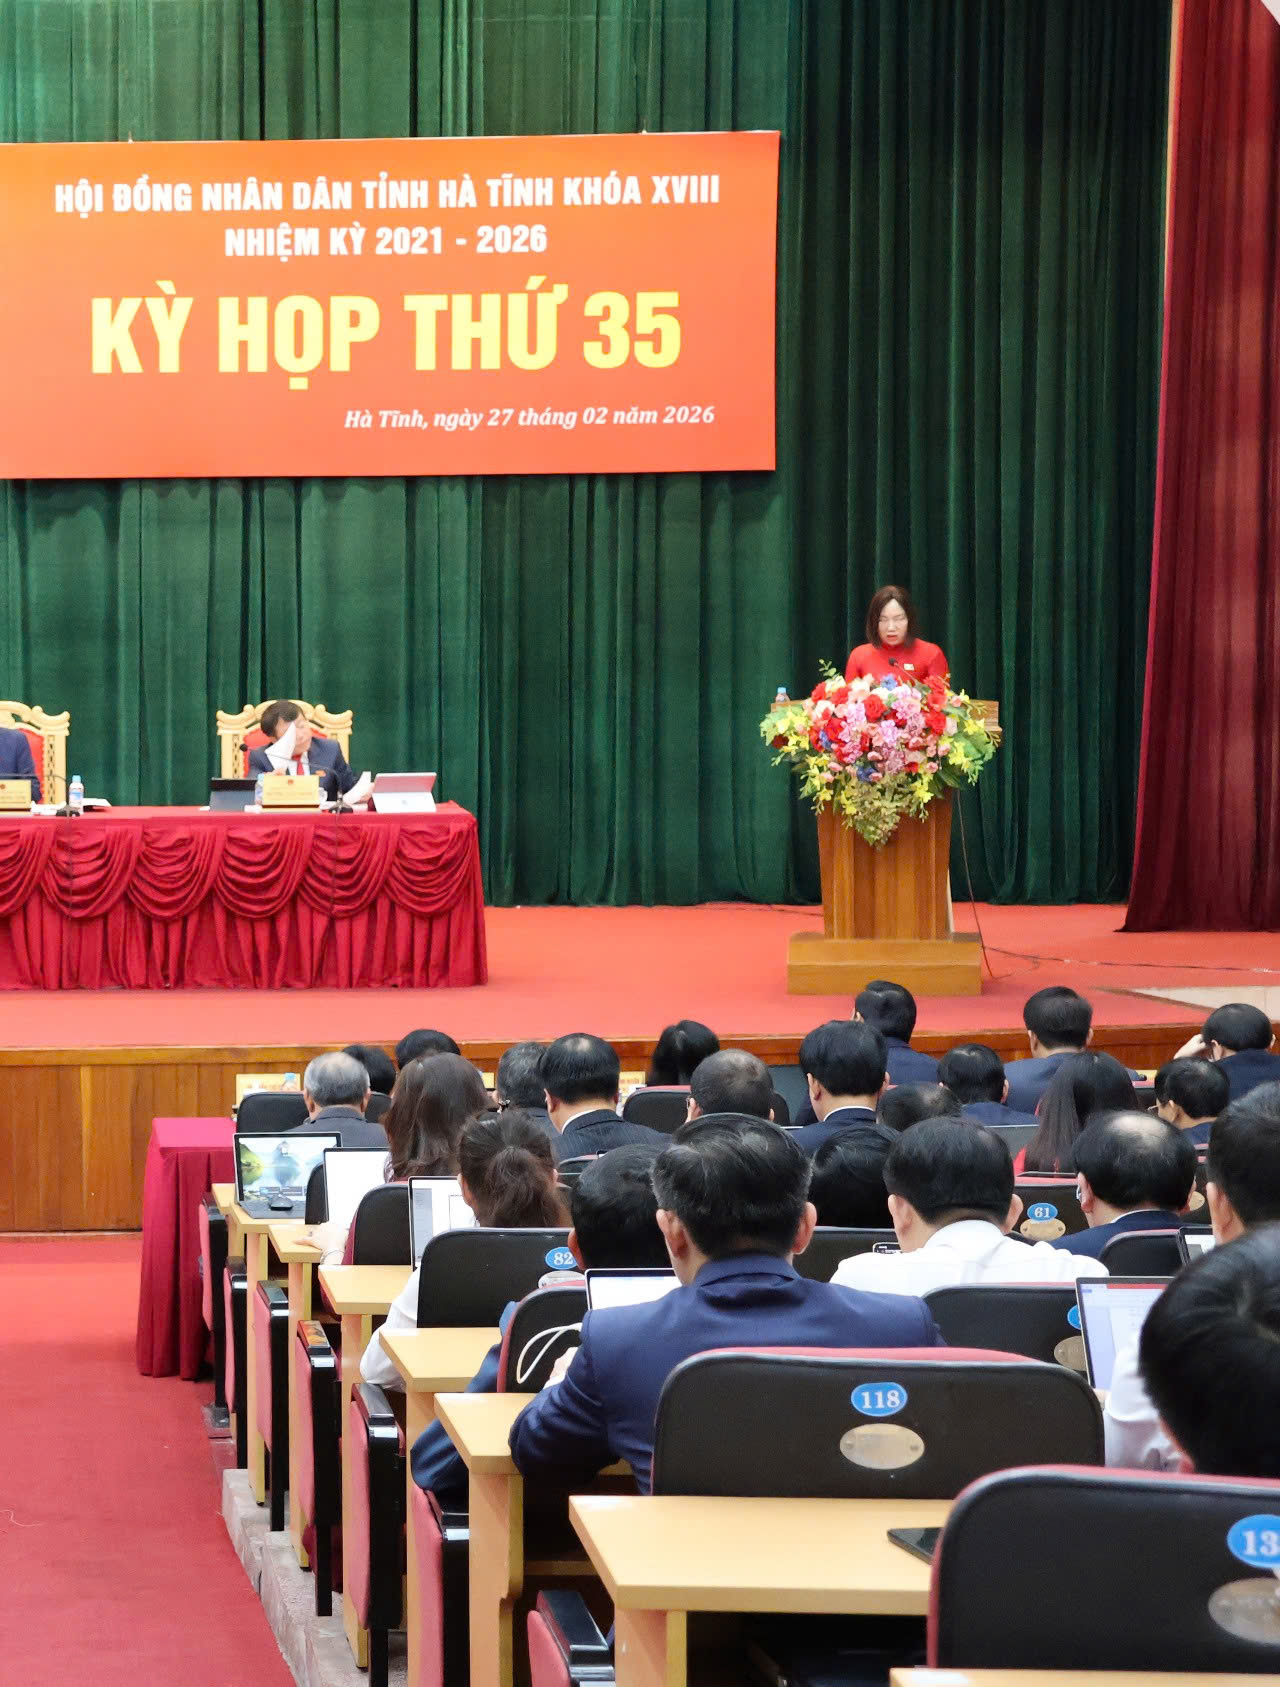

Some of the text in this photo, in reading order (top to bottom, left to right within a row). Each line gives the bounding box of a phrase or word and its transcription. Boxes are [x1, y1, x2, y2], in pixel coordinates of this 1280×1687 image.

[55, 170, 720, 219] HỘI ĐỒNG NHÂN DÂN TỈNH HÀ TĨNH KHÓA XVIII
[224, 221, 548, 262] NHIỆM KỲ 2021 - 2026
[91, 275, 681, 391] KỲ HỌP THỨ 35
[343, 405, 715, 433] Hà Tĩnh, ngày 27 tháng 02 năm 2026
[1034, 1207, 1051, 1218] 61
[553, 1251, 574, 1266] 82
[860, 1389, 901, 1411] 118
[1243, 1529, 1280, 1556] 13
